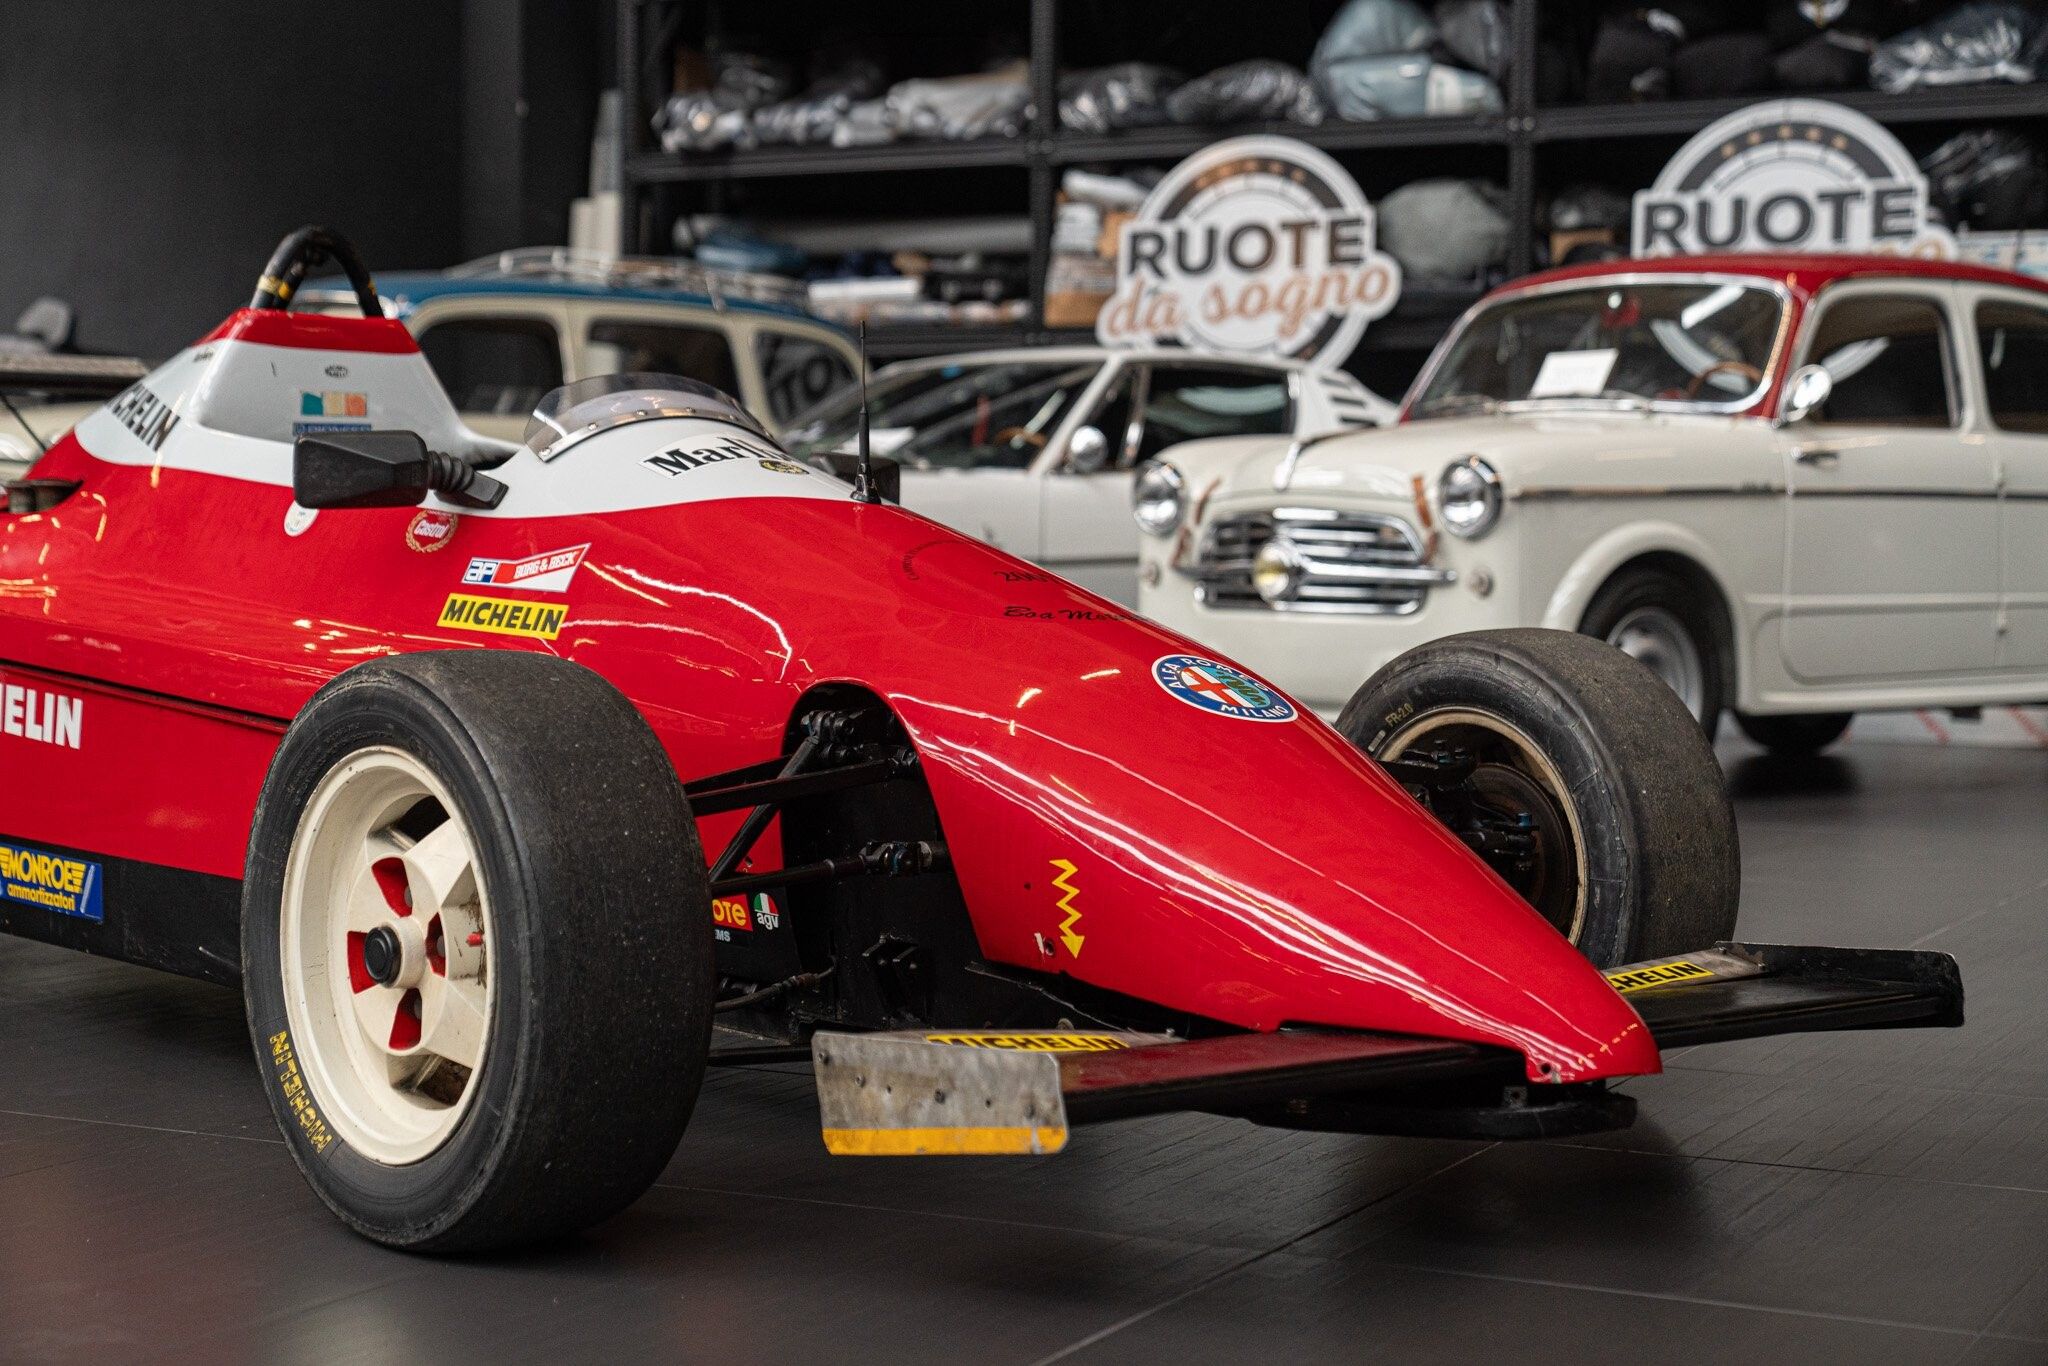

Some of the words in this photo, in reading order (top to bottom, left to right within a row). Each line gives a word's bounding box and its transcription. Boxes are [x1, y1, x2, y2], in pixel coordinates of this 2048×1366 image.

[1643, 186, 1917, 256] RUOTE
[1127, 217, 1366, 279] RUOTE
[1106, 277, 1184, 338] da
[1202, 265, 1391, 342] sogno
[540, 558, 549, 570] &
[443, 599, 563, 633] MICHELIN
[1161, 662, 1186, 690] ALFA
[0, 683, 83, 750] ELIN
[1220, 704, 1289, 718] MILANO
[0, 847, 86, 894] MONROE
[756, 912, 779, 930] agv
[269, 1030, 333, 1154] MICHELIN
